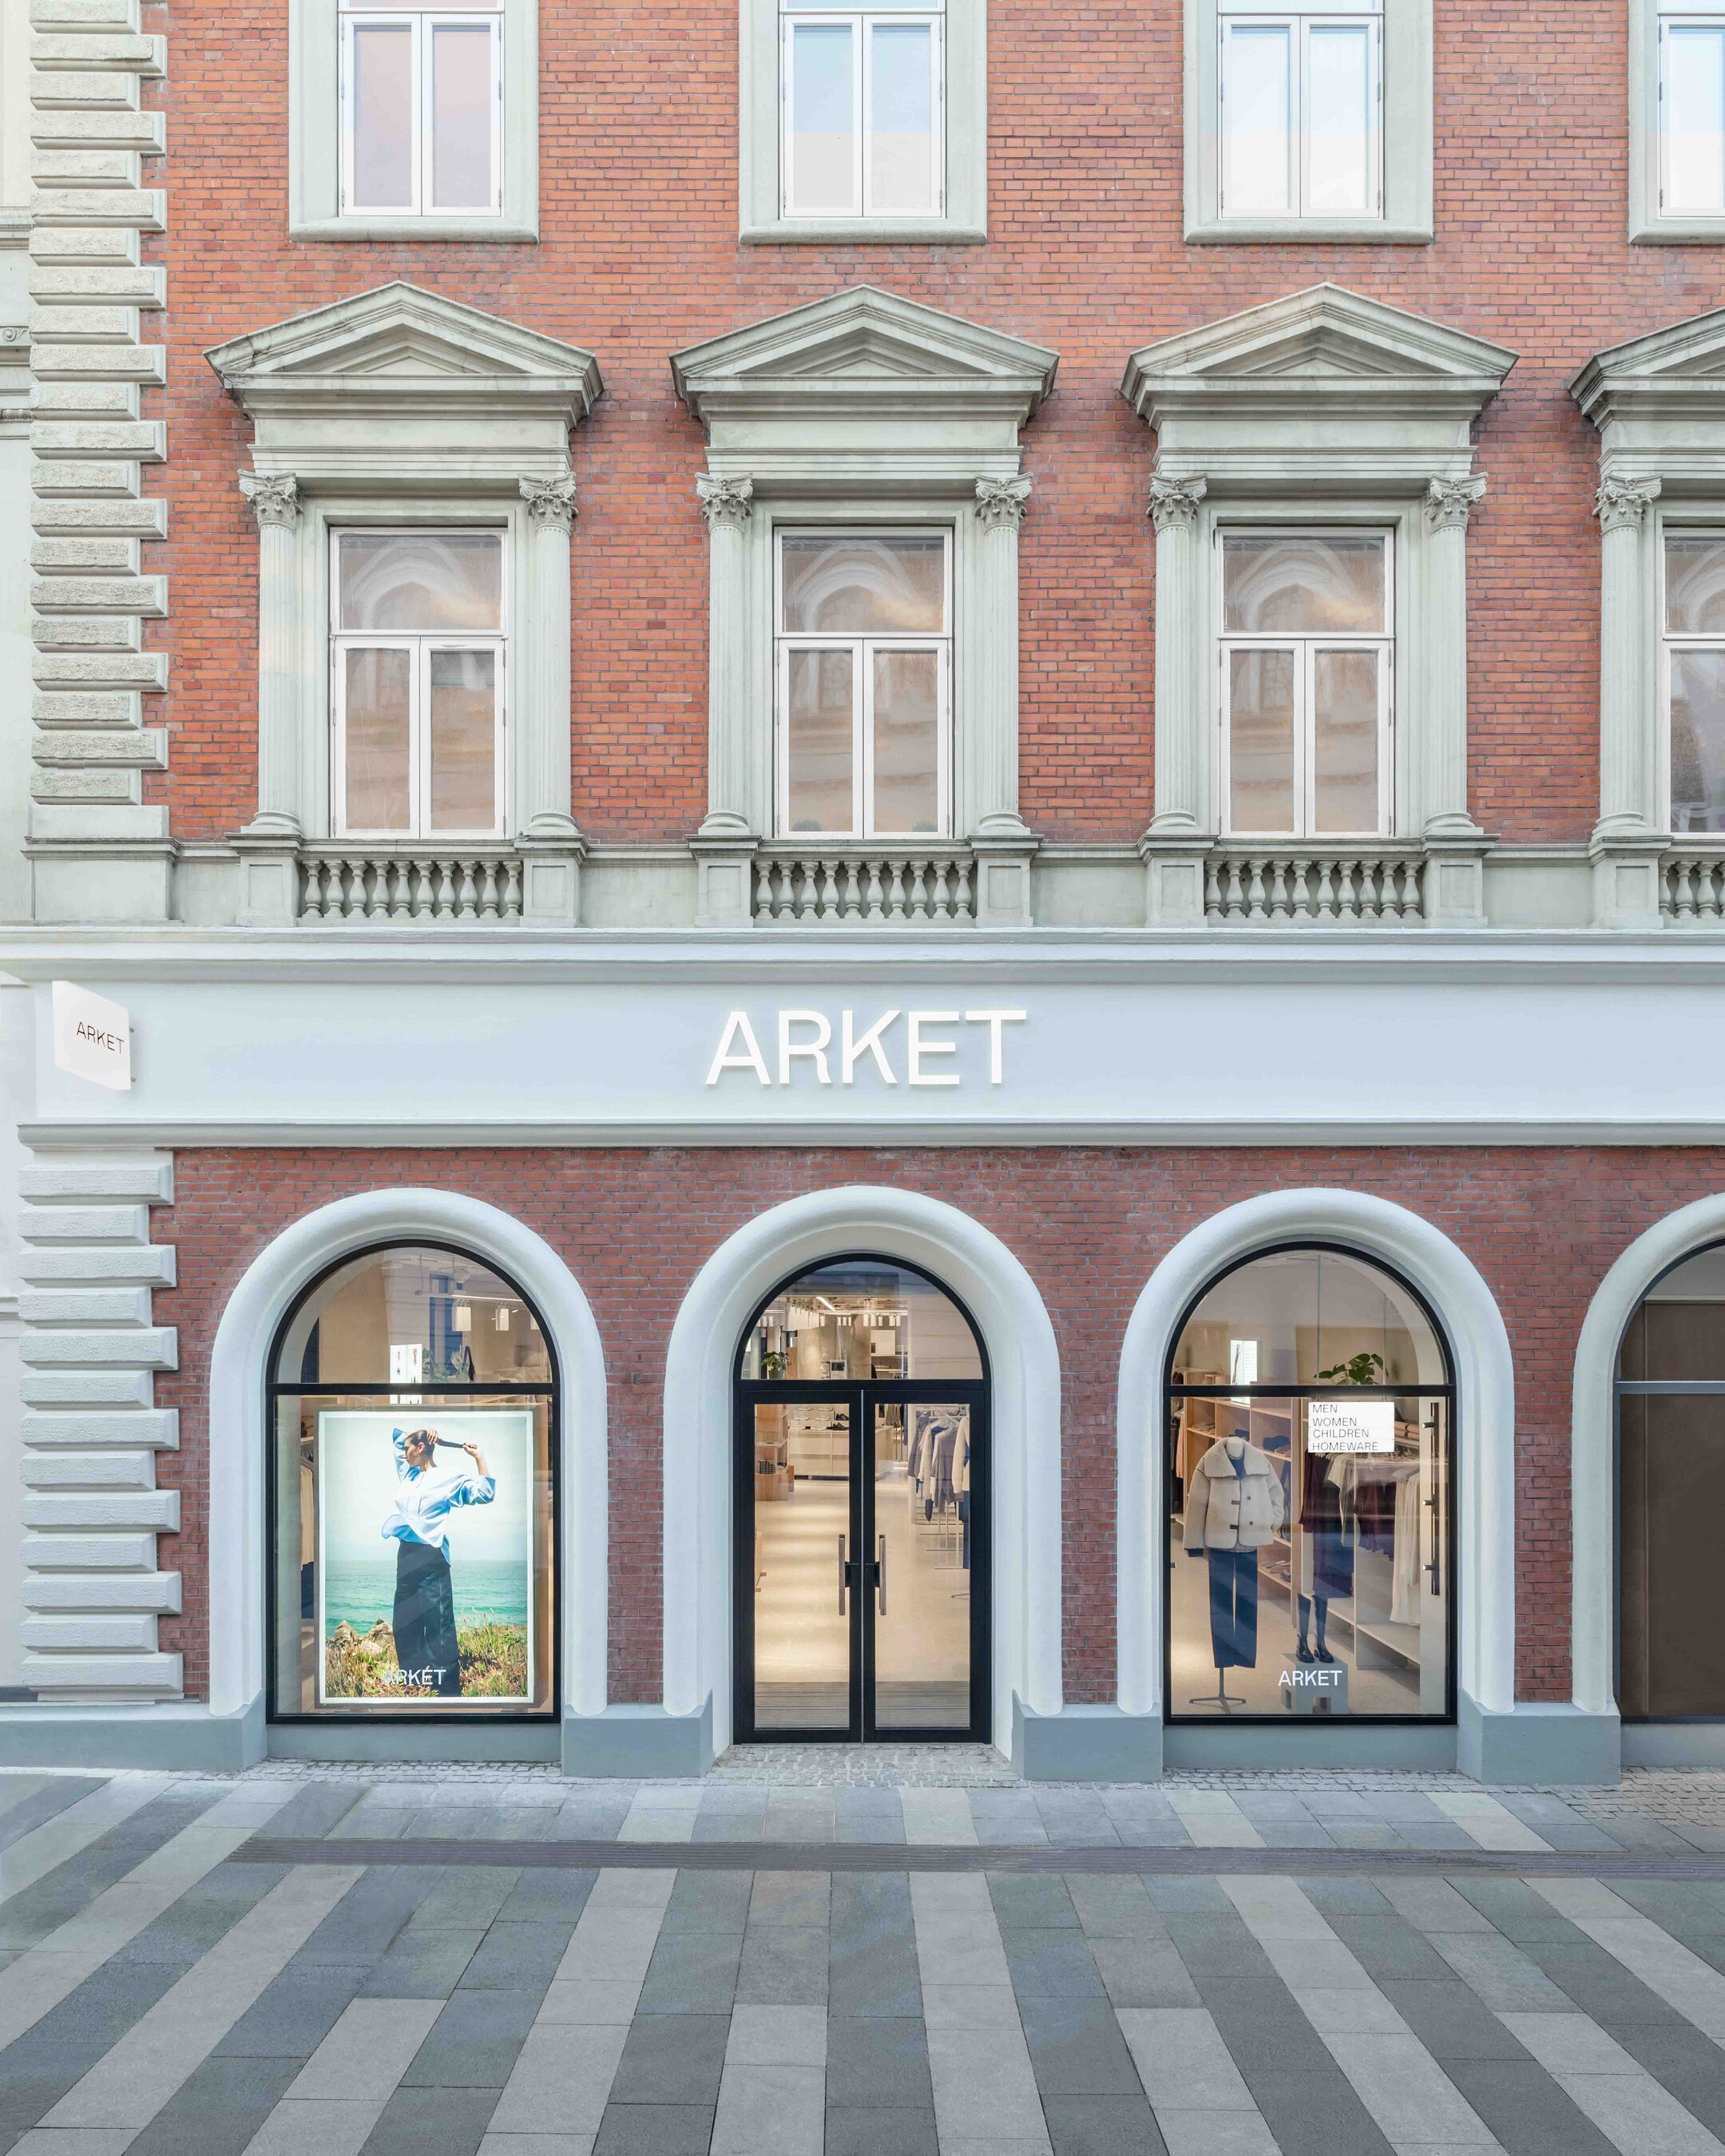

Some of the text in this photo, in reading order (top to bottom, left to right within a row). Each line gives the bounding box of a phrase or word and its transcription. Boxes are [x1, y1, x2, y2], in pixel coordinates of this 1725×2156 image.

[76, 1021, 125, 1054] ARKET
[705, 1010, 1027, 1084] ARKET
[1312, 1404, 1338, 1413] MEN
[1312, 1417, 1357, 1427] WOMEN
[1313, 1429, 1370, 1438] CHILDREN
[1312, 1441, 1378, 1451] HOMEWARE
[383, 1669, 447, 1685] ARKET
[1278, 1671, 1343, 1686] ARKET
